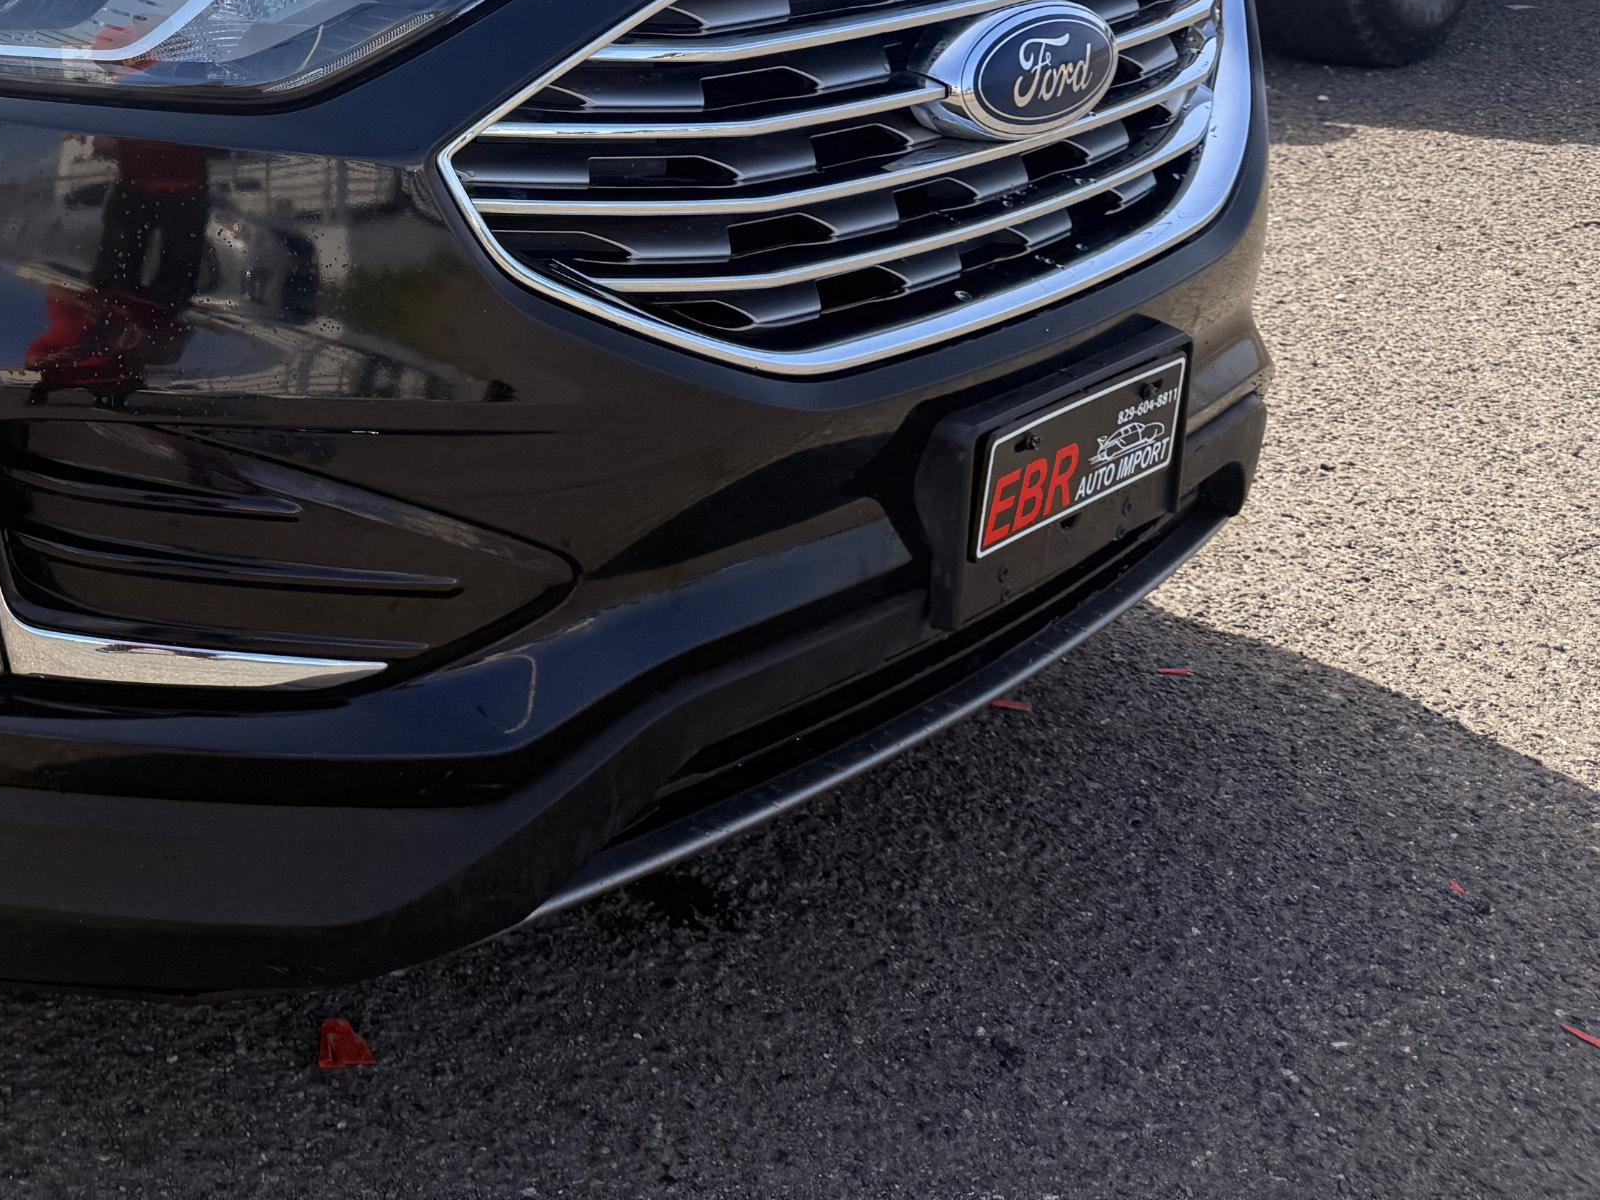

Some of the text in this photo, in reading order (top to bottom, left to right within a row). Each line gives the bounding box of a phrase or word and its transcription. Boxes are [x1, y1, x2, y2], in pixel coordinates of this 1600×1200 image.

[1013, 33, 1093, 108] Ford
[1117, 387, 1179, 426] 829-604-8811
[983, 443, 1080, 547] EBR
[1075, 437, 1171, 501] AUTO IMPORT
